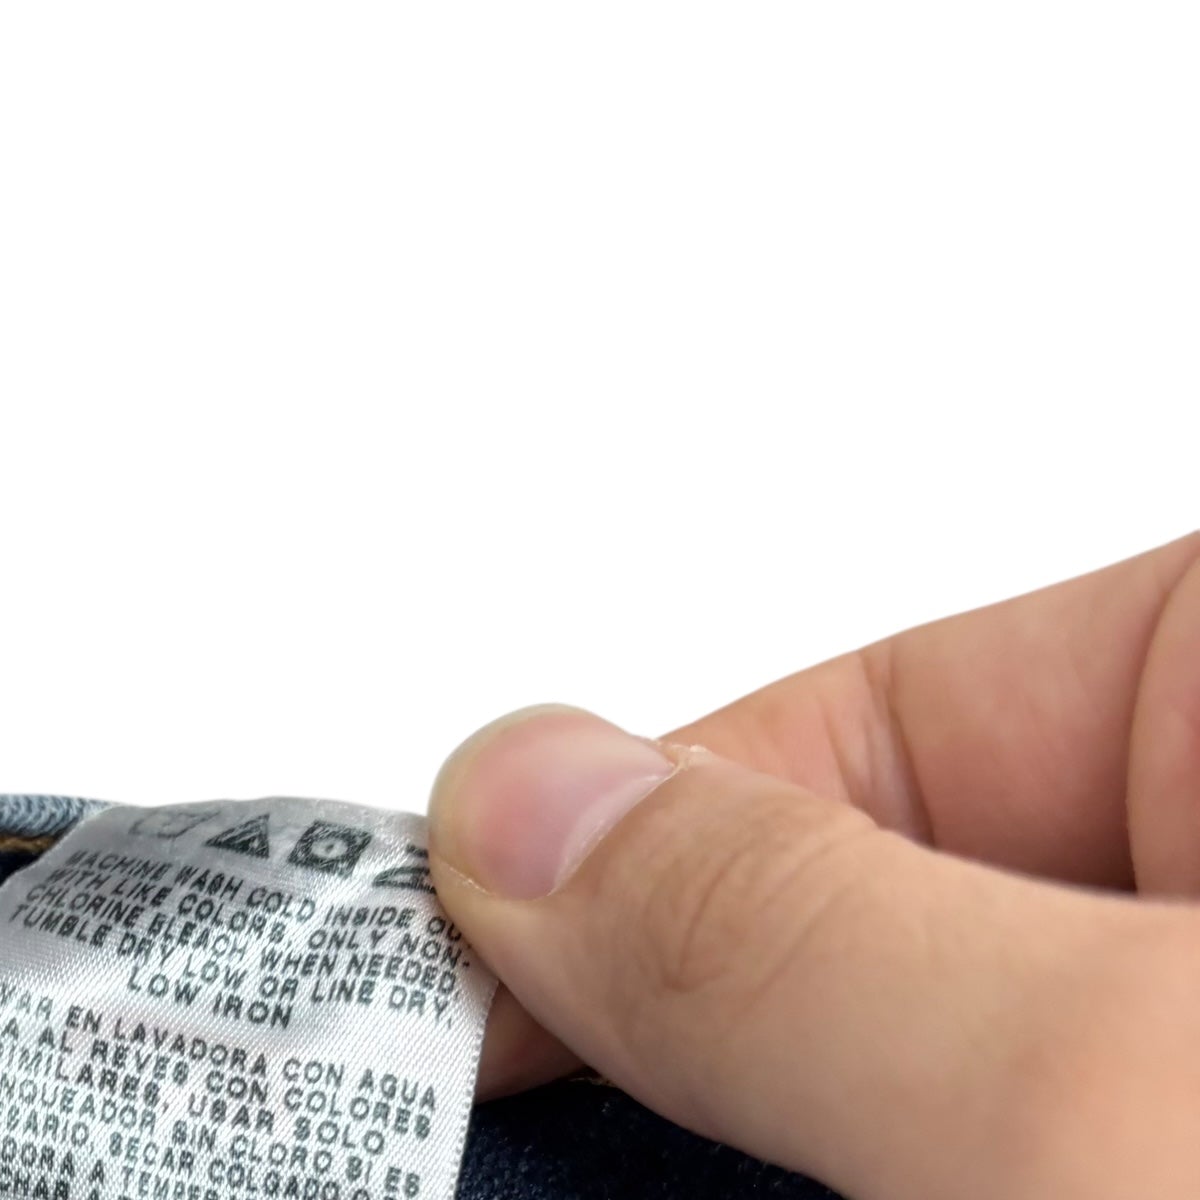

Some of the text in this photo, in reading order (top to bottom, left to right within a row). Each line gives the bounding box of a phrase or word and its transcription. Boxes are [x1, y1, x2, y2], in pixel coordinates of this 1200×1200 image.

[26, 884, 144, 928] CHLORINE
[148, 913, 248, 962] BLEACH
[260, 949, 338, 977] WHEN
[46, 868, 110, 890] WITH
[112, 879, 173, 907] LIKE
[308, 929, 388, 951] ONLY
[399, 933, 470, 969] NON-
[65, 849, 467, 944] MACHINE WASH COLD INSIDE OU
[9, 904, 112, 948] TUMBLE
[118, 932, 176, 966] DRY
[183, 953, 247, 990] LOW
[259, 976, 299, 1001] OR
[311, 979, 376, 1005] LINE
[128, 966, 293, 1029] LOW IRON
[38, 1026, 72, 1054] AL
[90, 1039, 189, 1085] REVES
[205, 1070, 269, 1106] CON
[283, 1085, 431, 1140] COLORES
[66, 1005, 103, 1034] EN
[114, 1017, 267, 1078] LAVADORA
[282, 1057, 344, 1088] CON
[358, 1068, 435, 1111] AGUA
[109, 1132, 194, 1177] SECAR
[171, 1119, 218, 1152] SIN
[230, 1134, 332, 1174] CLORO
[345, 1156, 373, 1185] SI
[384, 1166, 420, 1198] ES
[187, 1092, 275, 1135] USAR
[293, 1115, 384, 1156] SOLO
[88, 1159, 105, 1185] A
